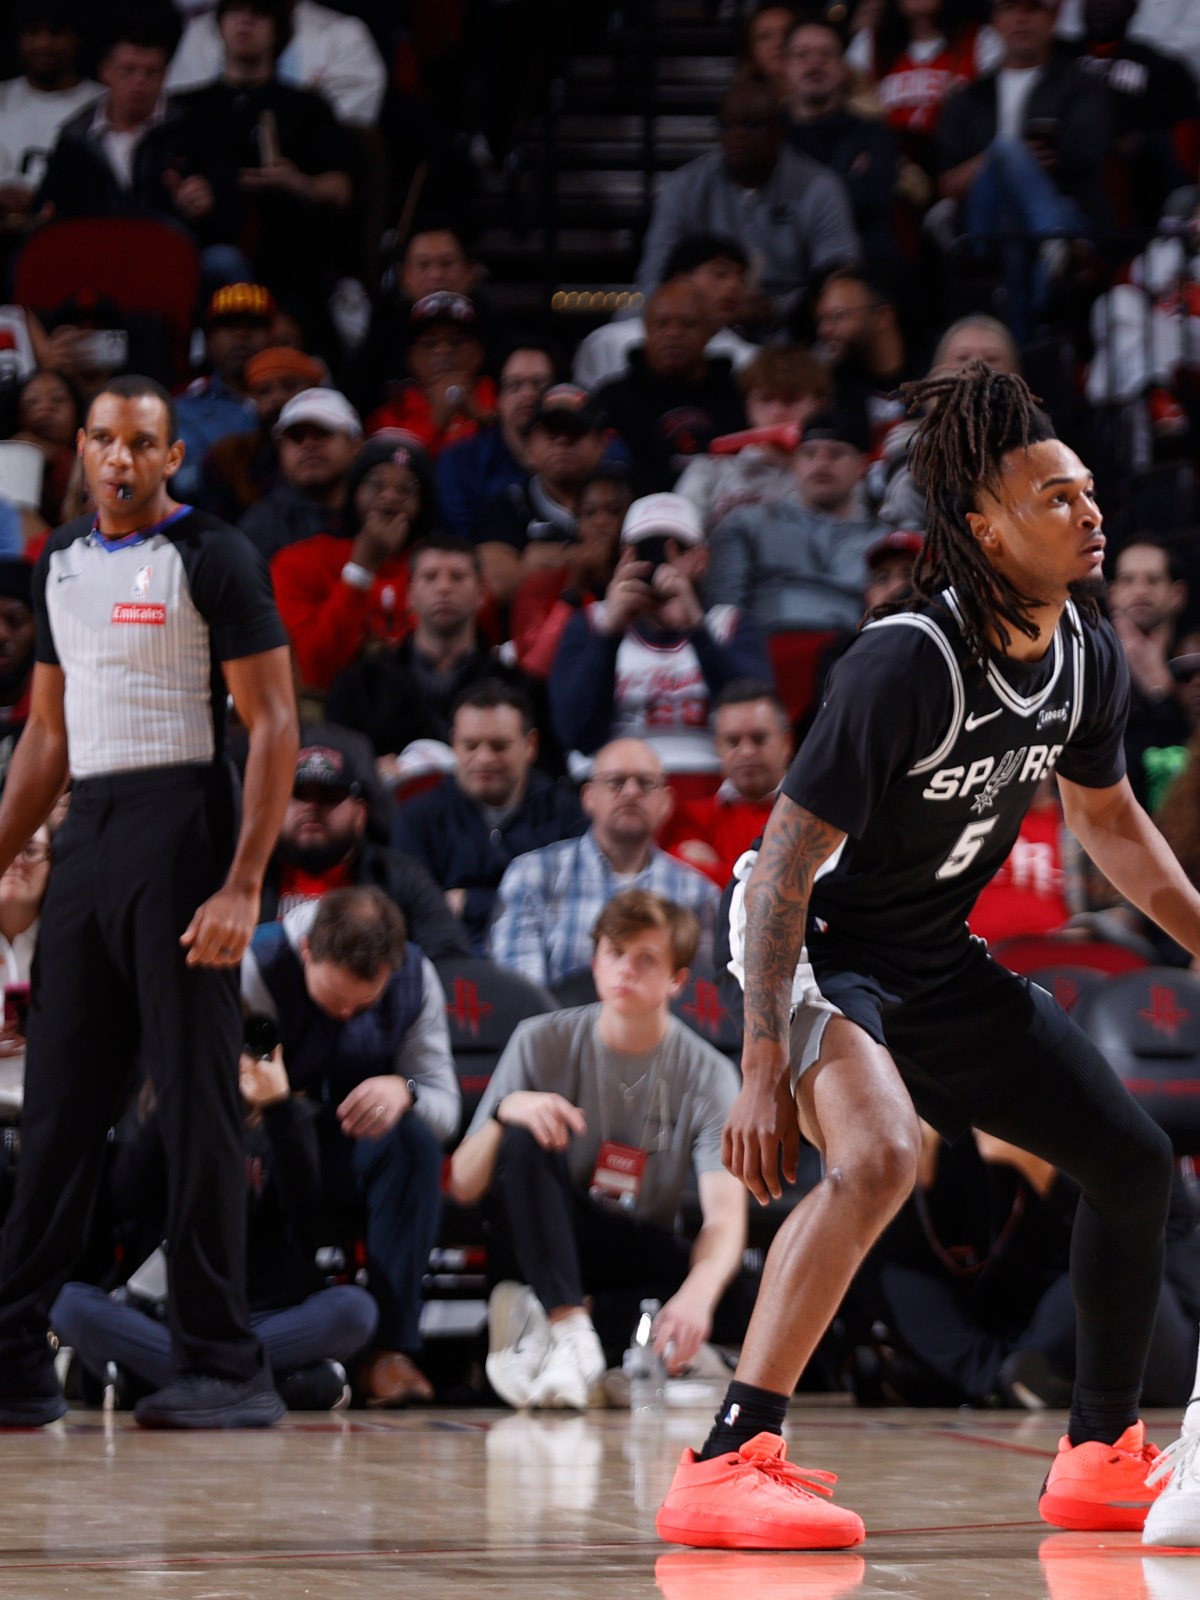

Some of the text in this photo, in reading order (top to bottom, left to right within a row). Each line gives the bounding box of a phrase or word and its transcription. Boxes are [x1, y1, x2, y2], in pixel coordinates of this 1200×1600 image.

[112, 604, 165, 620] Emirates
[923, 744, 1064, 807] SPURS
[935, 814, 999, 880] 5
